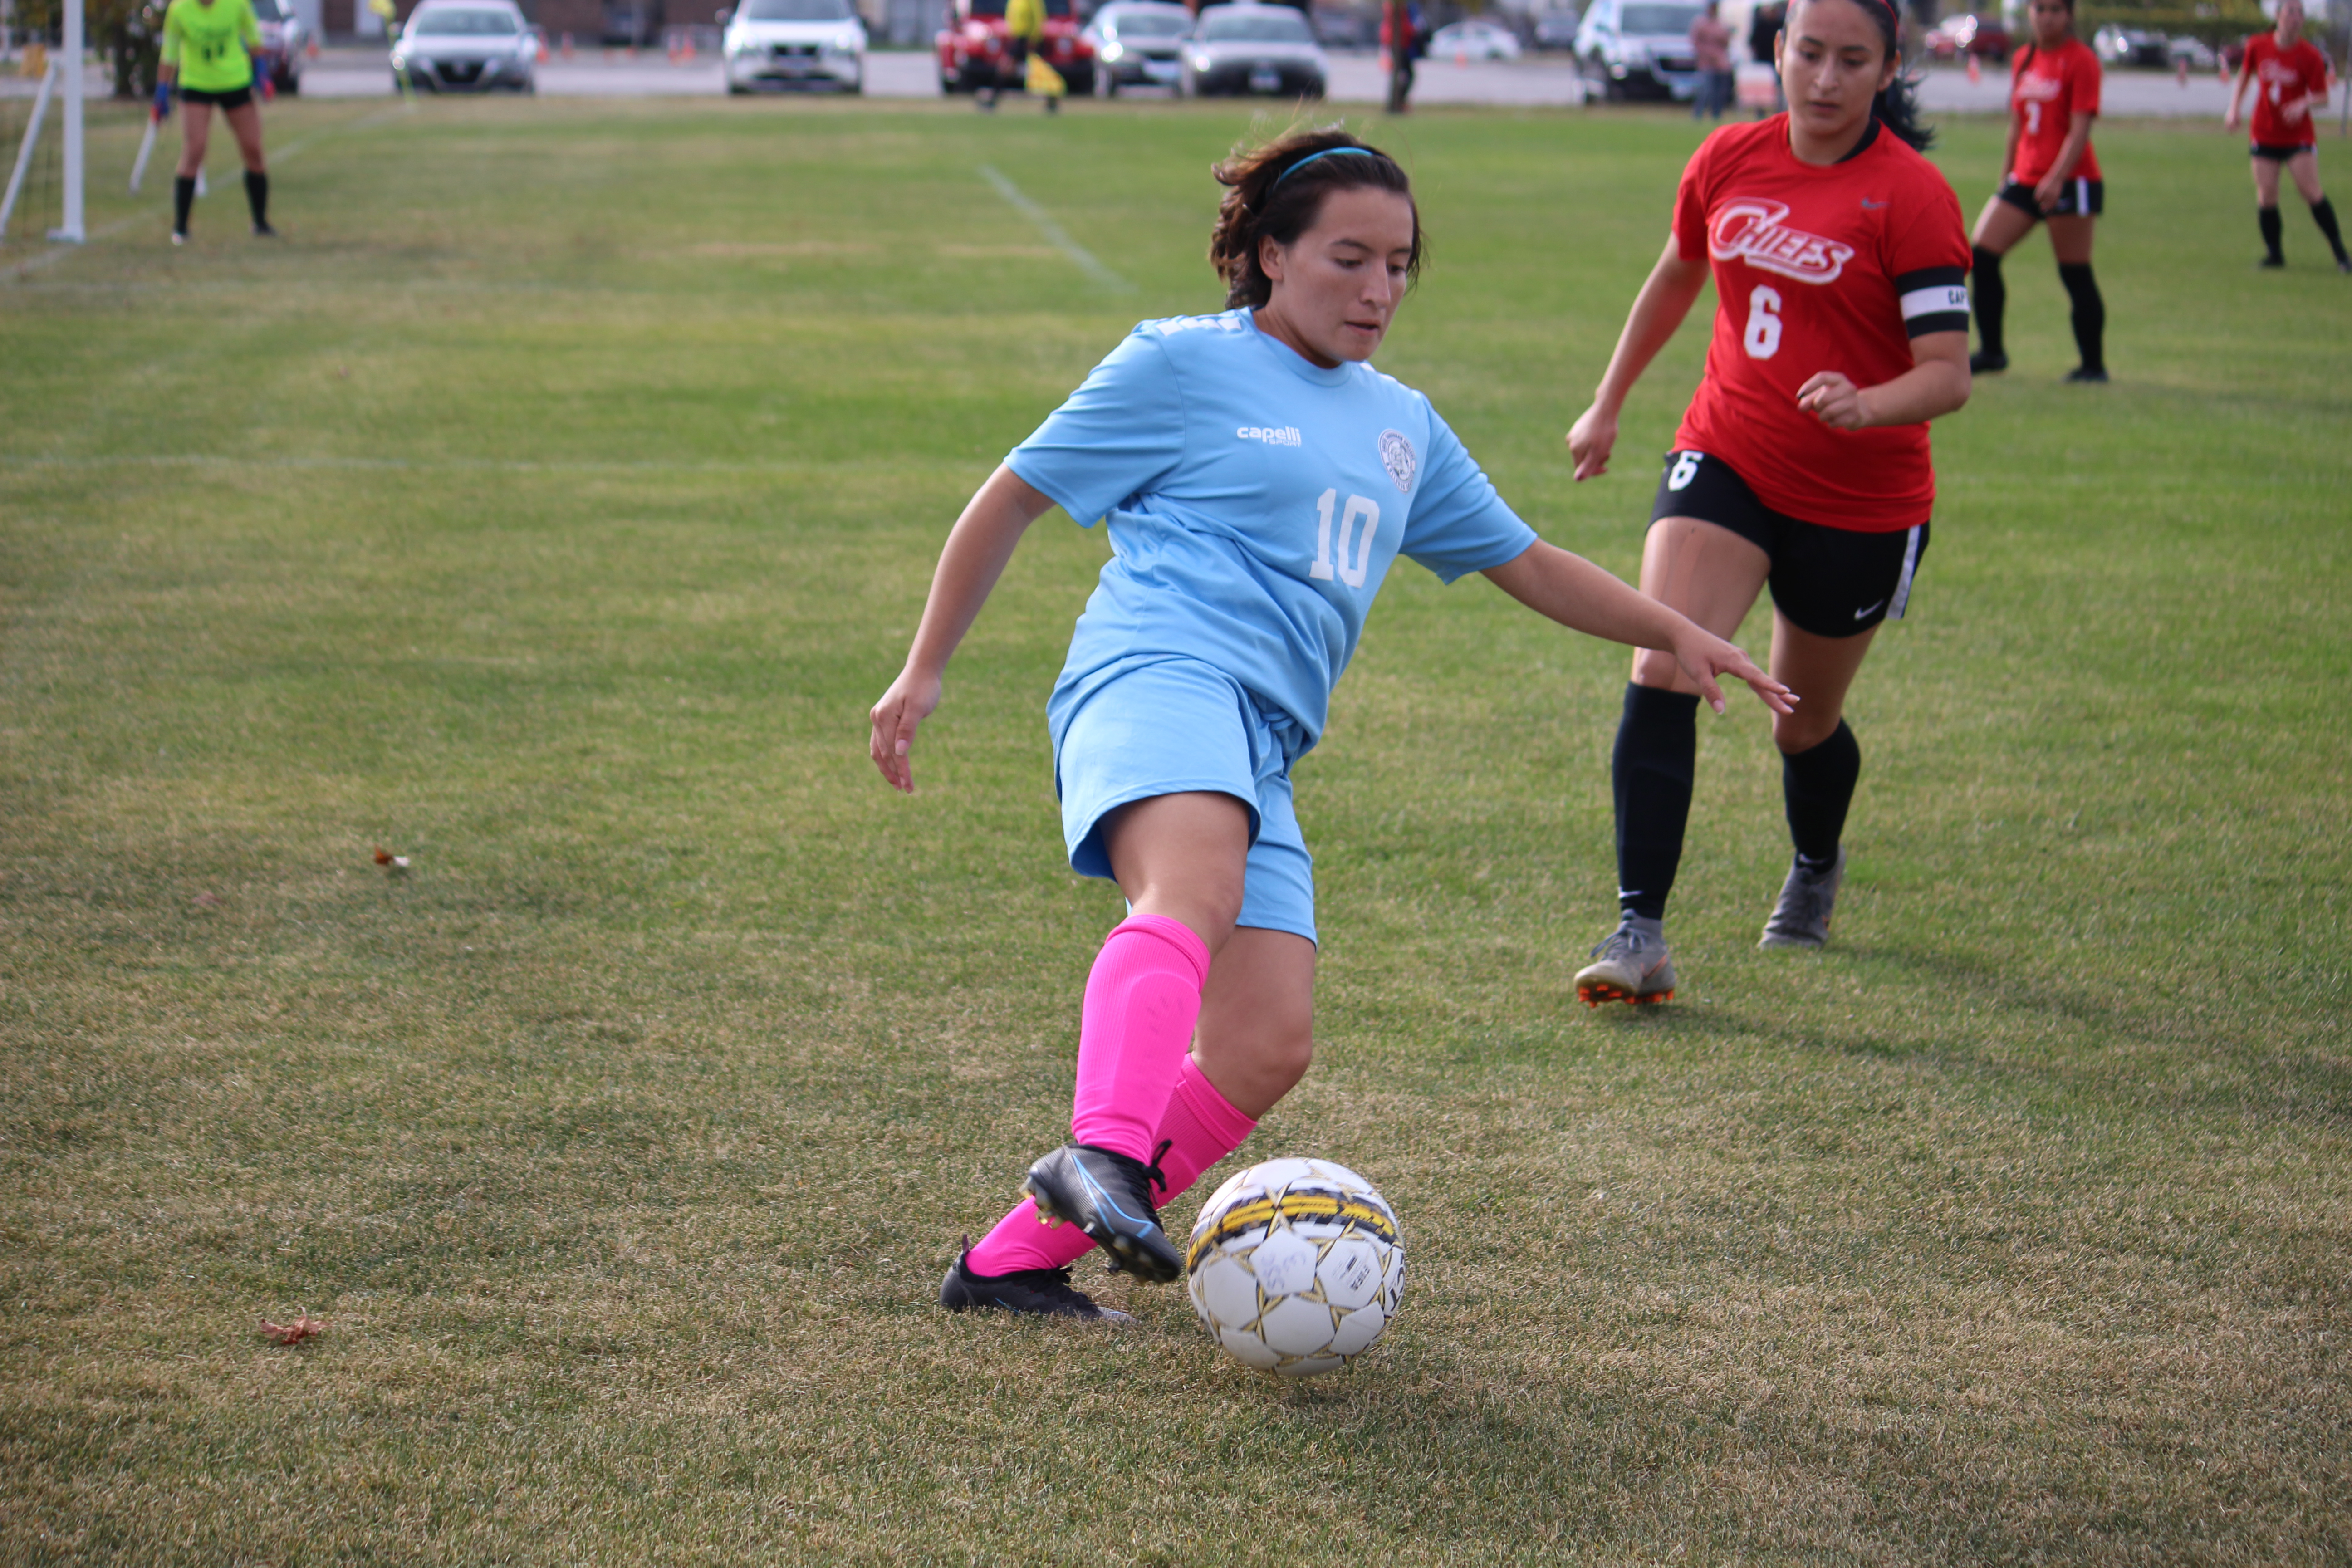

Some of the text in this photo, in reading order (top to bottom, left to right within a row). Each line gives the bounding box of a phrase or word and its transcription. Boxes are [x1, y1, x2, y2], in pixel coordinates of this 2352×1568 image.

[1948, 290, 1968, 305] CAP
[1744, 283, 1782, 361] 6
[1236, 426, 1301, 443] capelli
[1269, 438, 1301, 447] SPORT
[1667, 449, 1704, 492] 6
[1309, 488, 1379, 588] 10
